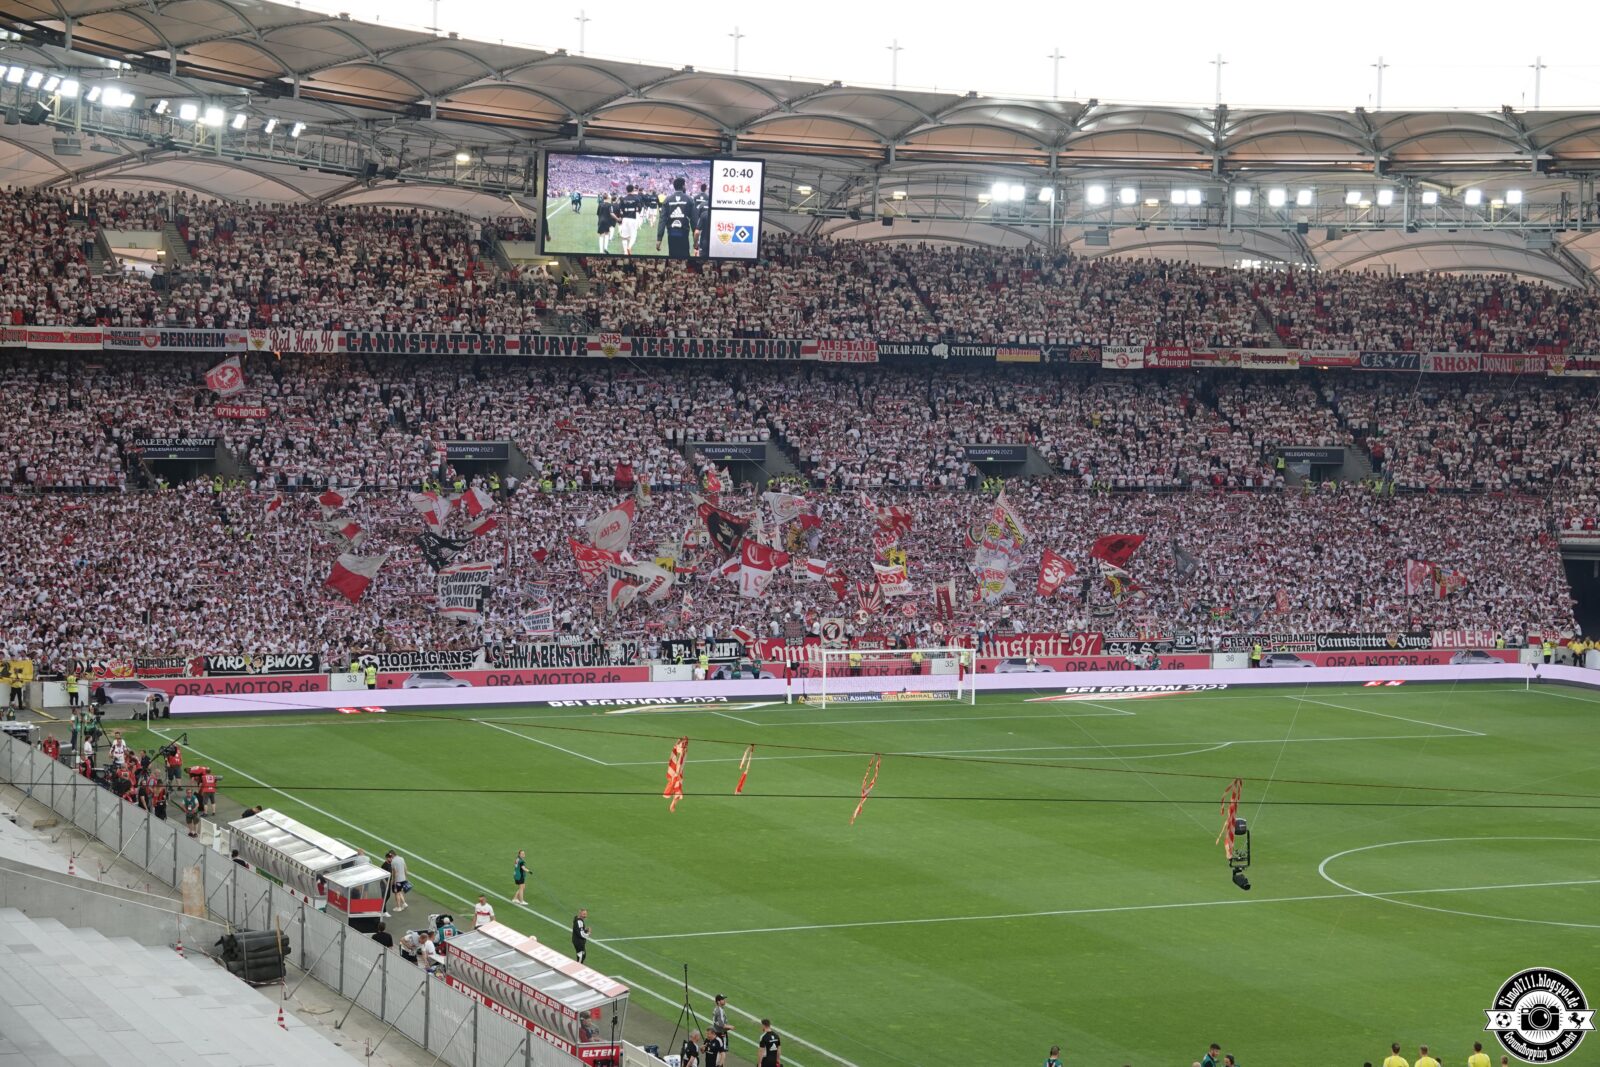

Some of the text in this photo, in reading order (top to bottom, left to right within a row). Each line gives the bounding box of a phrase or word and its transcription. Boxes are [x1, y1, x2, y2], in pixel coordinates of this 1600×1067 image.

[723, 168, 753, 178] 20:40
[723, 184, 751, 193] 04:14
[716, 198, 756, 206] www.vfb.de
[160, 332, 226, 347] BERKHEIM
[346, 332, 588, 356] CANNSTATTER KURVE
[631, 337, 802, 360] NECKARSTADION
[879, 344, 997, 357] NECKAR-FILS STUTTGART
[820, 351, 877, 362] VFB-FANS
[1317, 633, 1387, 648] Cannstatter
[208, 653, 313, 670] YARD BWOYS
[377, 650, 473, 667] HOOLIGANS
[347, 674, 357, 683] 33
[486, 668, 622, 687] ORA-MOTOR.de
[174, 679, 320, 697] ORA-MOTOR.de
[582, 1048, 617, 1057] ELTEN
